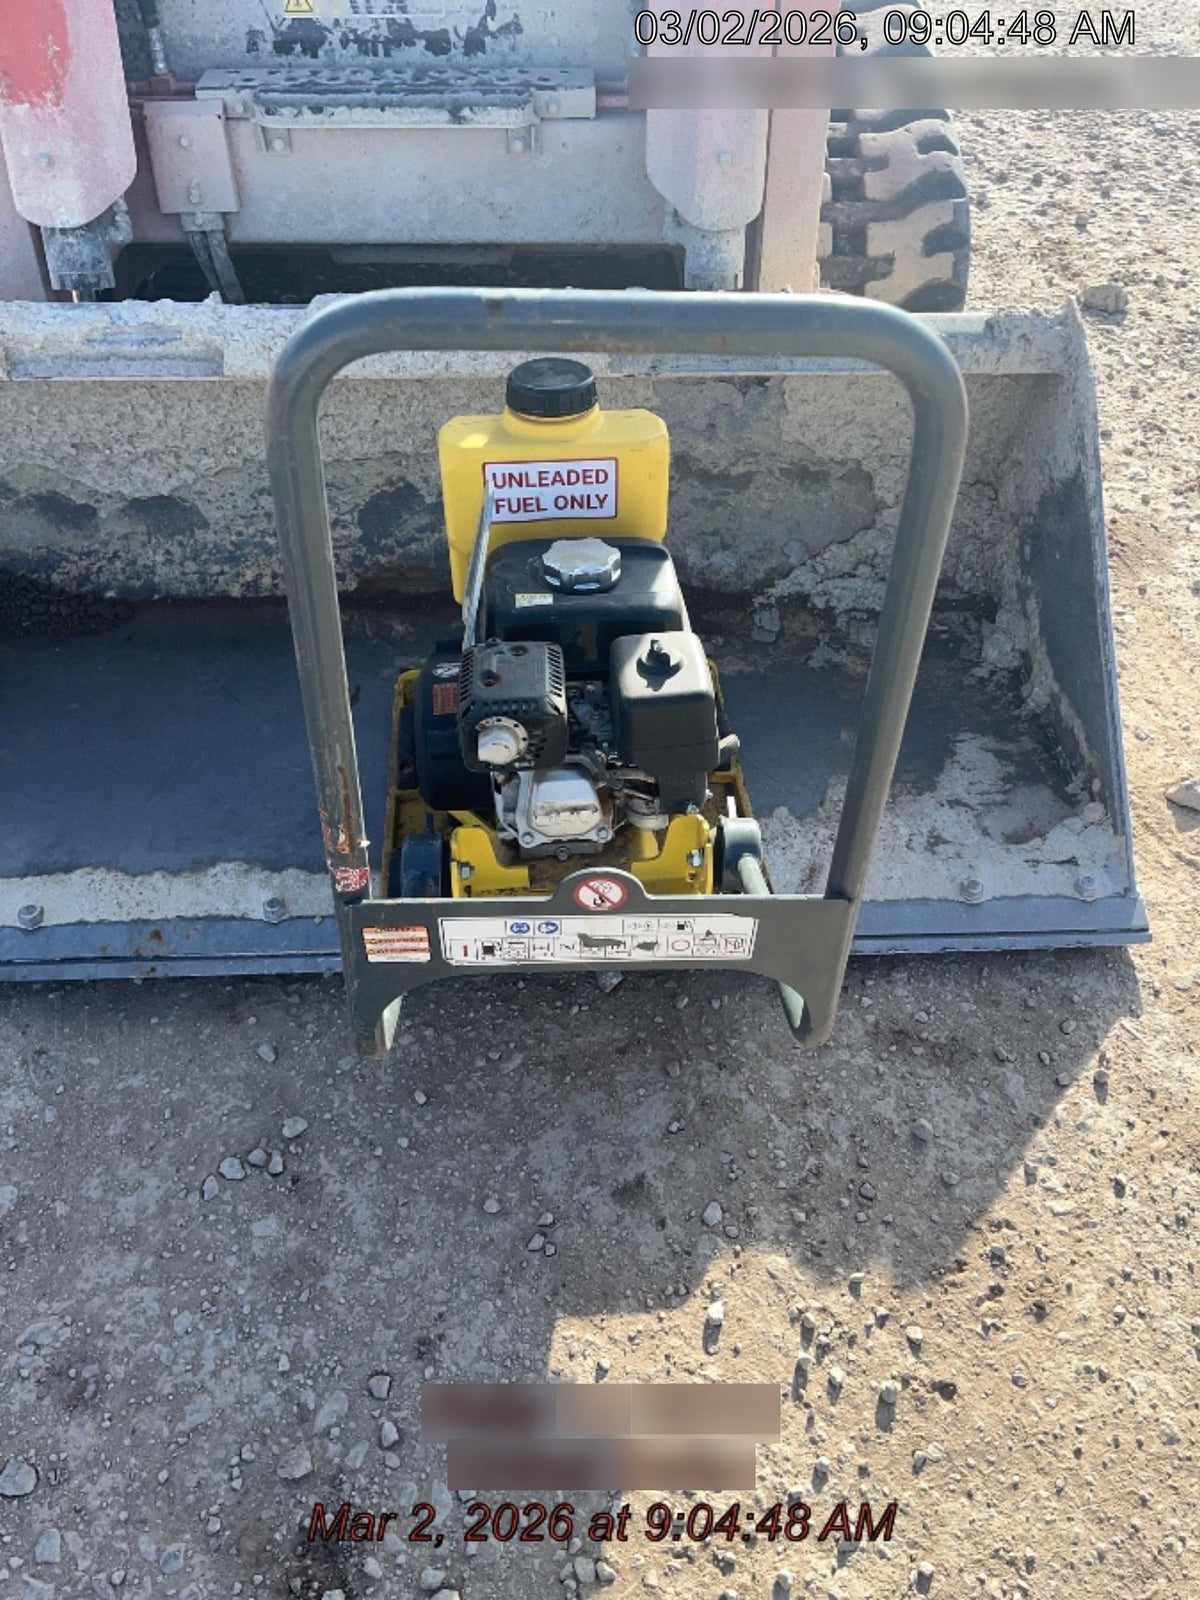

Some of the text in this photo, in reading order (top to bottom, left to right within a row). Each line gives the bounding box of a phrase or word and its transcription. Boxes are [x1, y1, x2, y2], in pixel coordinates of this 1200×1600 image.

[492, 468, 609, 490] UNLEADED
[494, 493, 609, 515] FUEL ONLY
